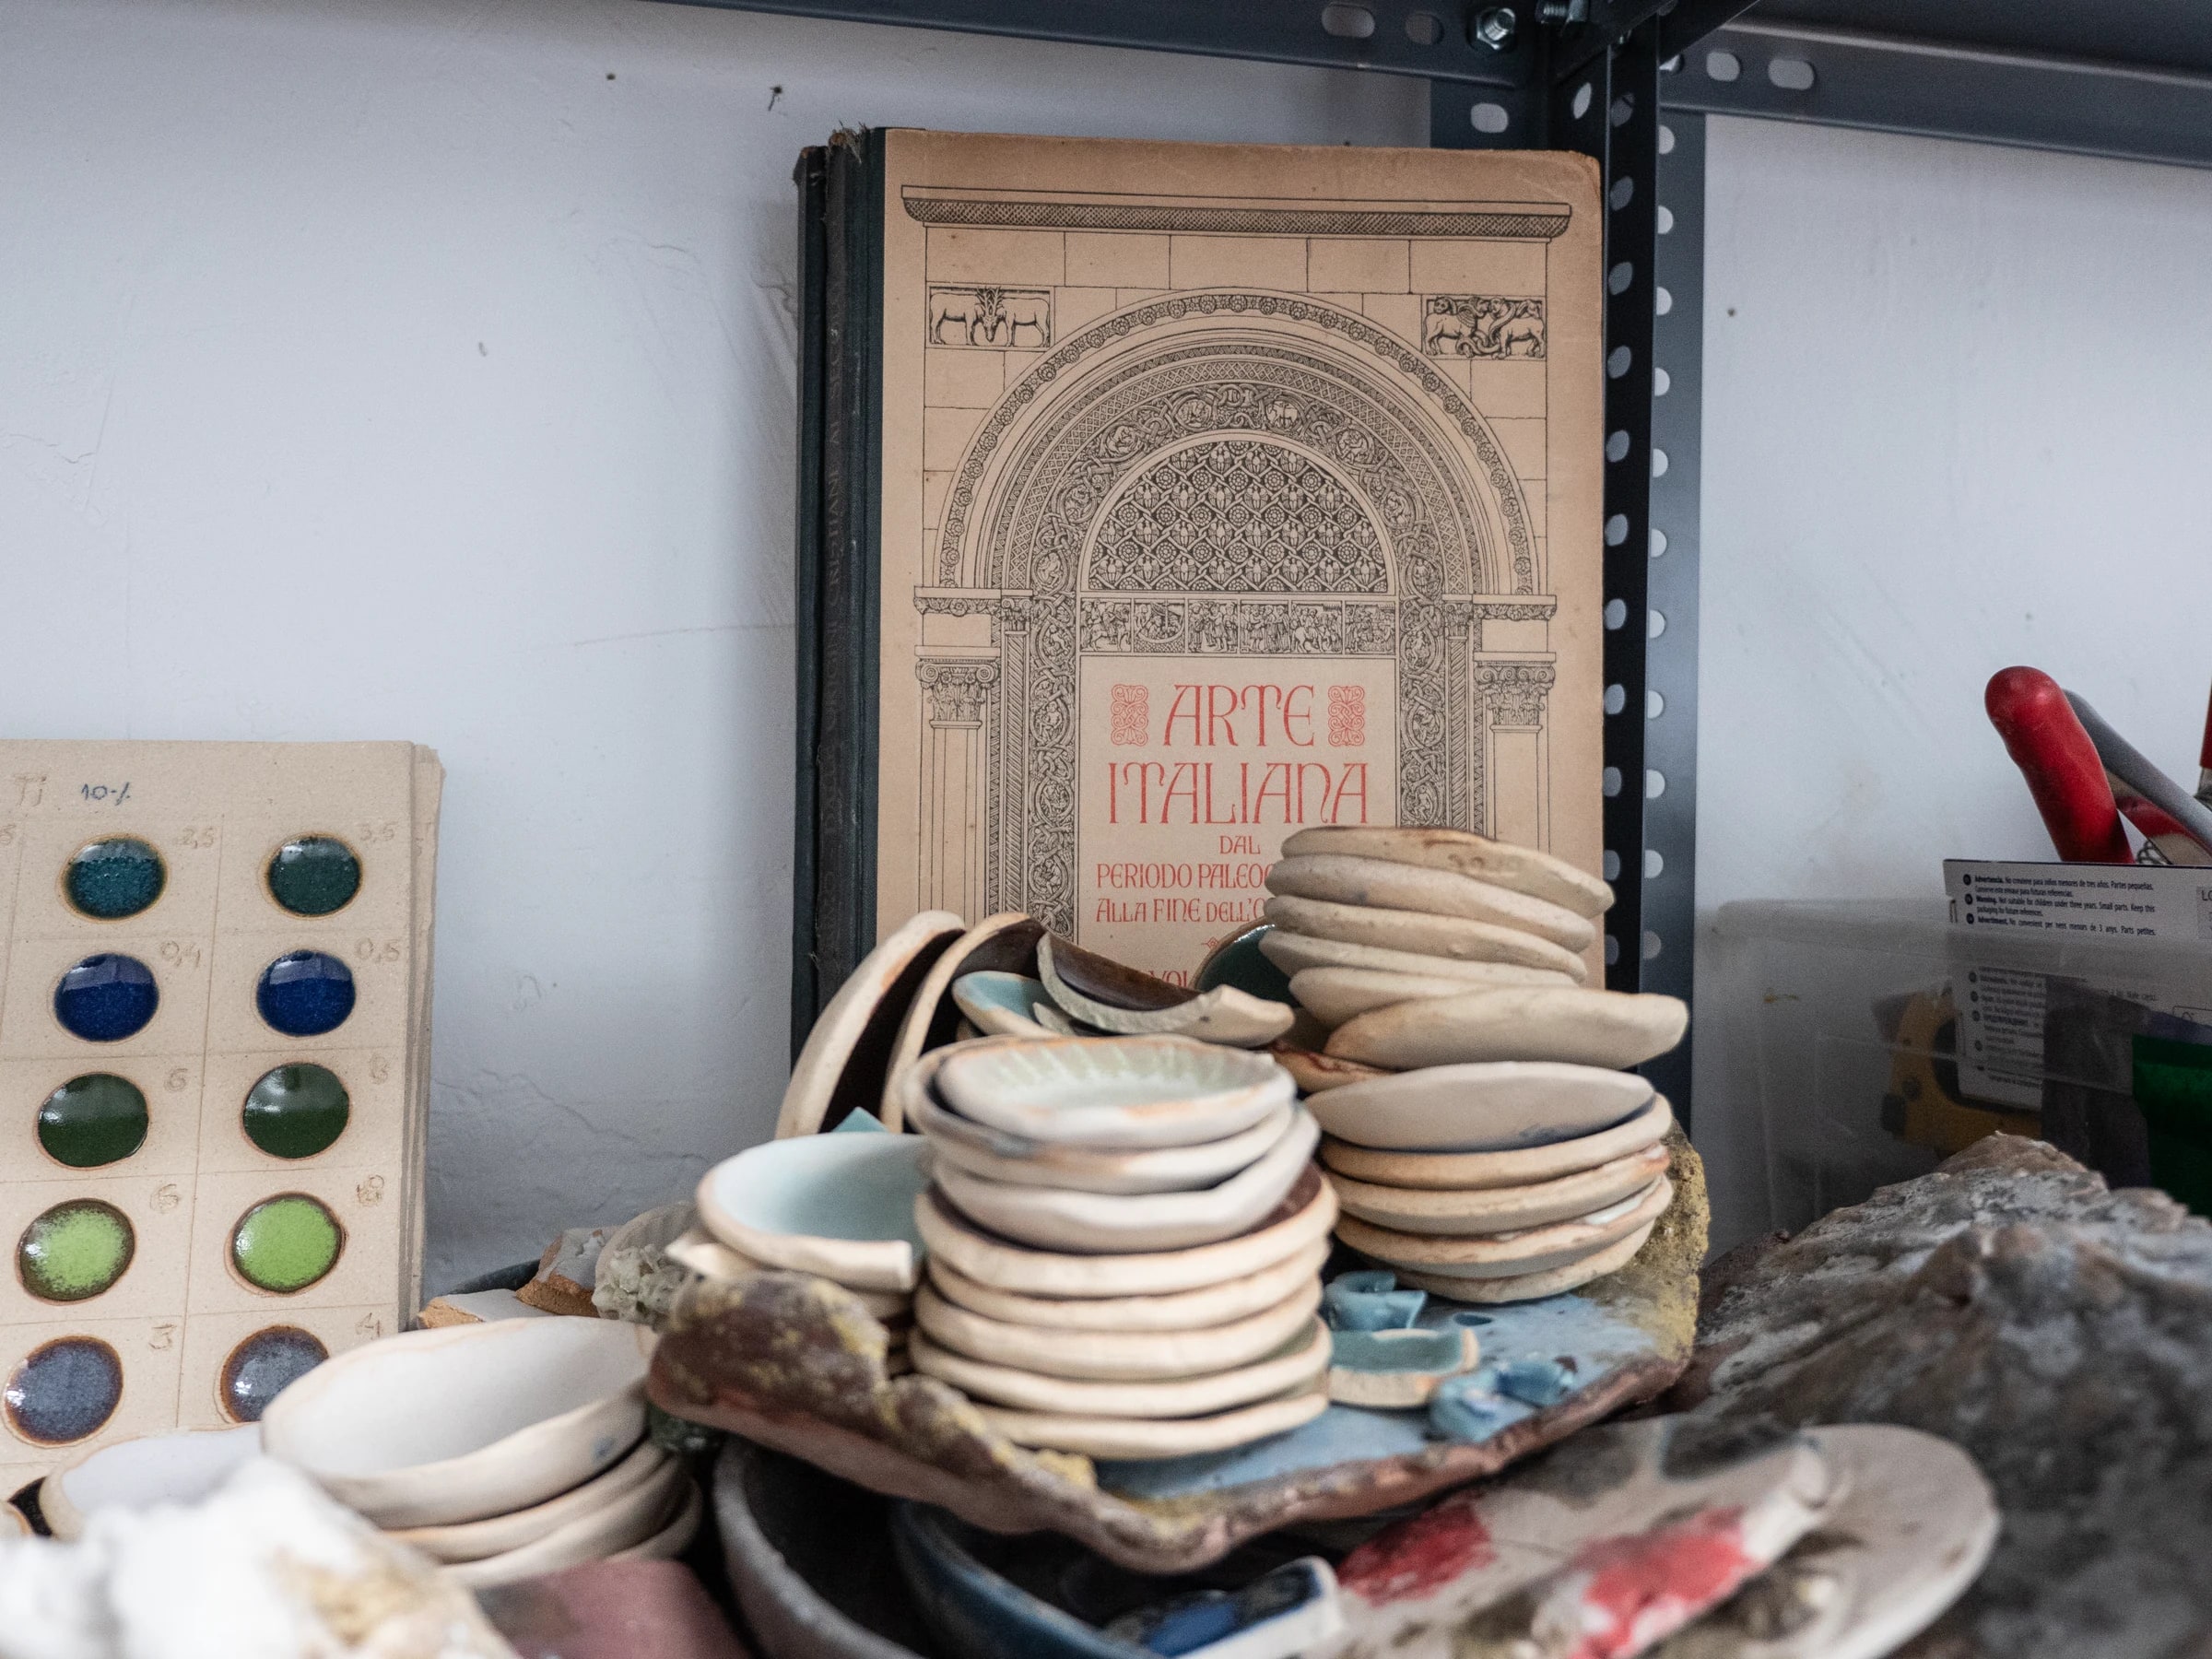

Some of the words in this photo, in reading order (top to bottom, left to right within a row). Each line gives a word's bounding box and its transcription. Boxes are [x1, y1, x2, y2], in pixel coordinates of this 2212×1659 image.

[1163, 684, 1314, 747] ARTE
[1109, 761, 1369, 824] ITALIANA
[1219, 835, 1261, 854] DAL
[1096, 863, 1193, 888] PERIODO
[1097, 899, 1147, 922] ALLA
[1154, 898, 1200, 922] FINE
